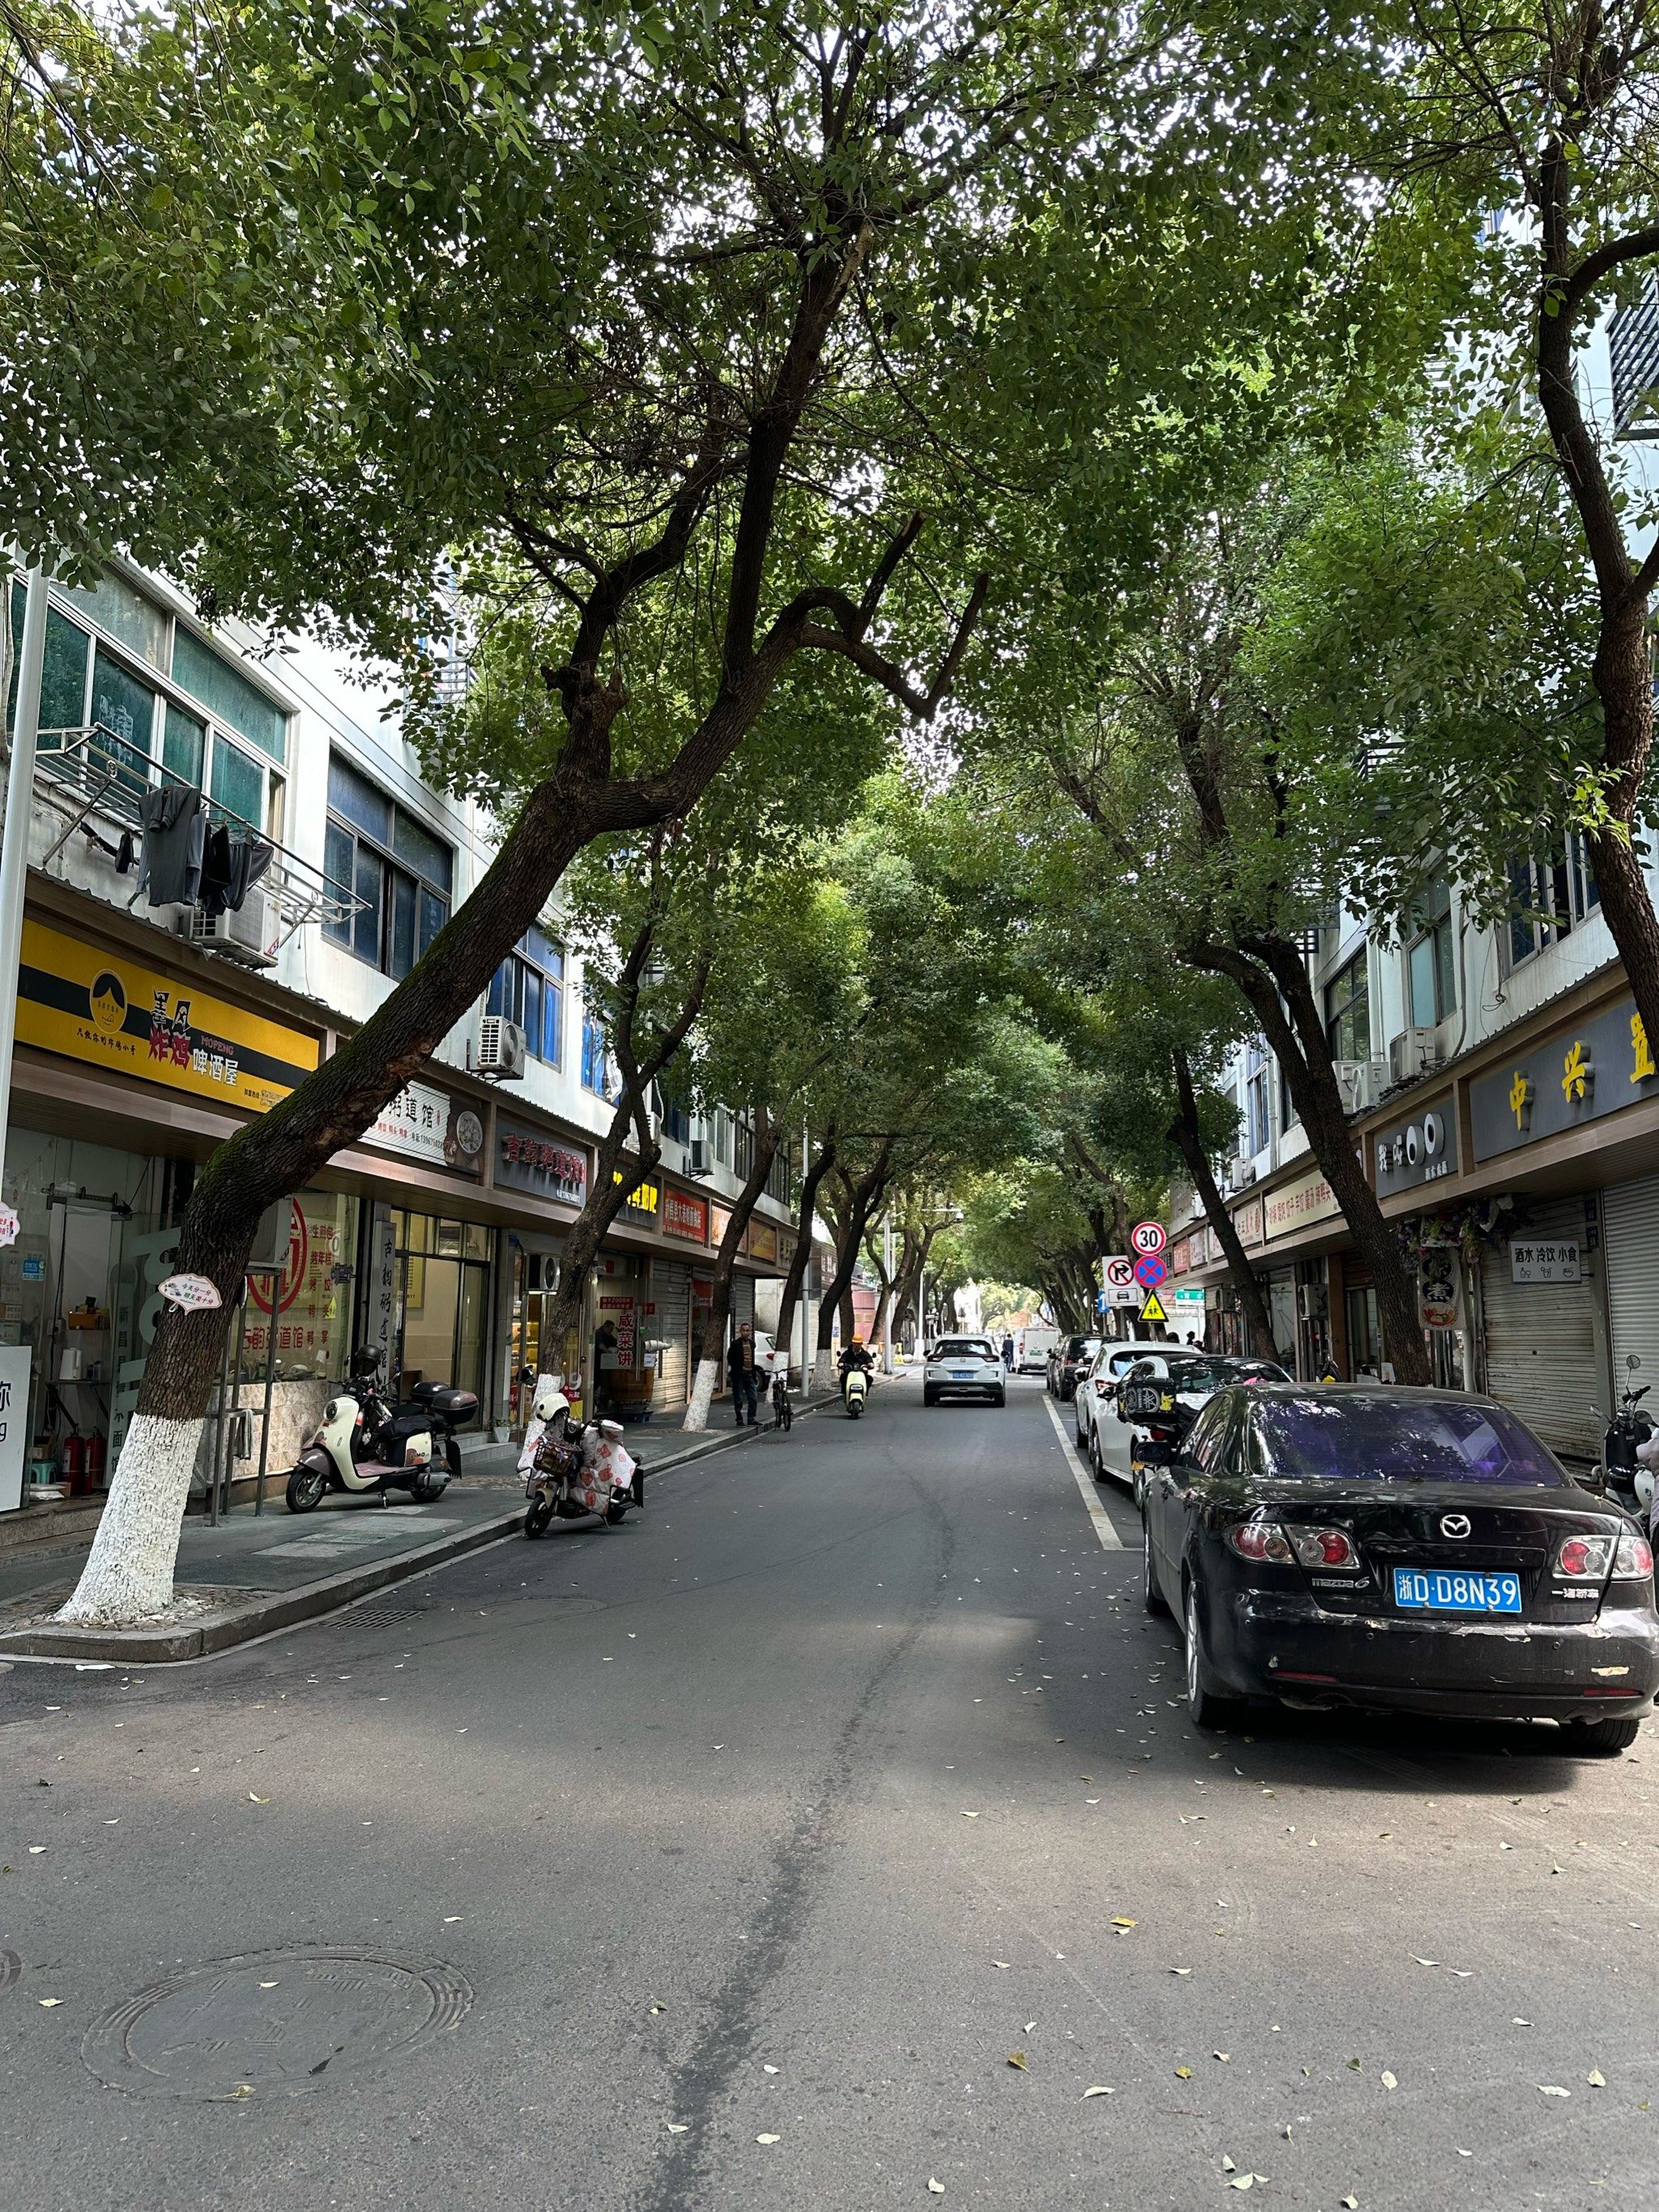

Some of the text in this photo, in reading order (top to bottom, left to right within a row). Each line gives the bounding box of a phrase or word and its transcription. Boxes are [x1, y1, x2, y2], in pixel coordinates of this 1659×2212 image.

[148, 1025, 190, 1071] 炸鸡
[193, 1048, 238, 1086] 啤酒屋
[1140, 1230, 1158, 1248] 30
[1515, 1246, 1578, 1263] 酒水 冷饮 小食
[377, 1238, 393, 1398] 古韵粥道馆
[617, 1313, 633, 1366] 咸菜饼
